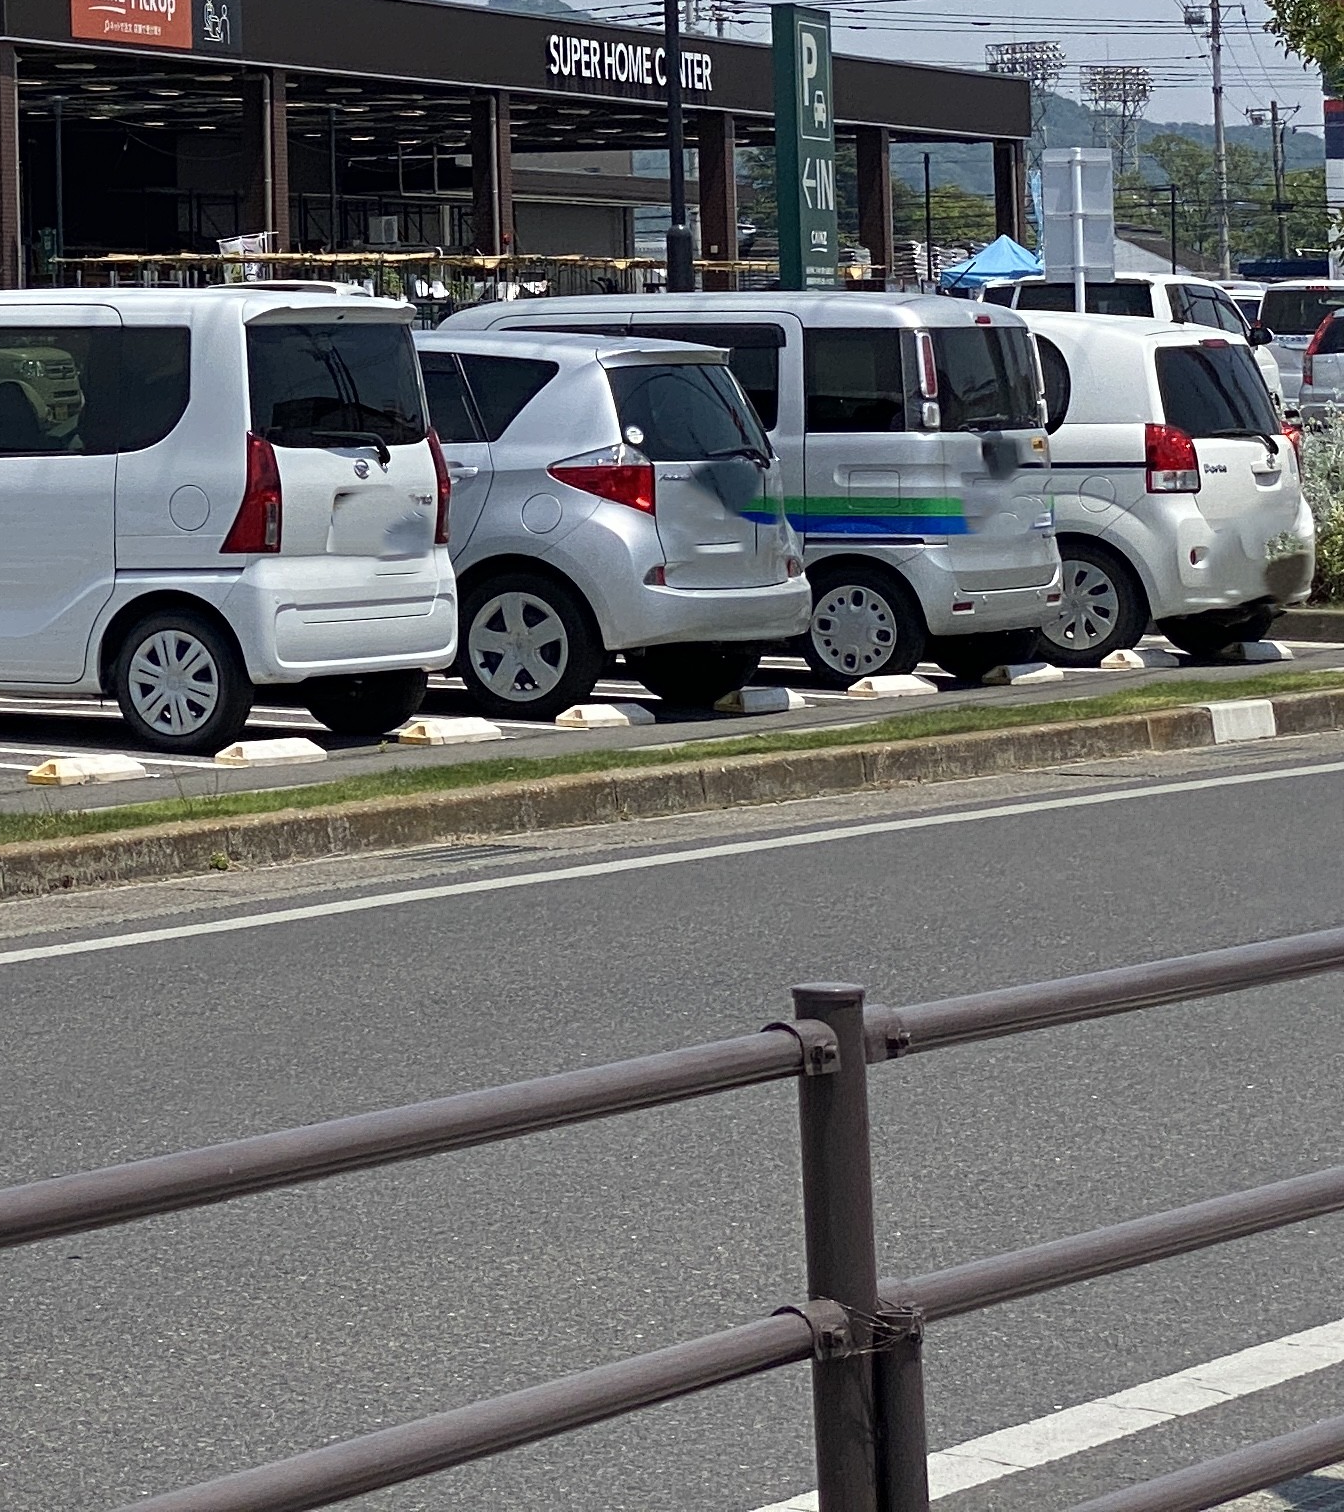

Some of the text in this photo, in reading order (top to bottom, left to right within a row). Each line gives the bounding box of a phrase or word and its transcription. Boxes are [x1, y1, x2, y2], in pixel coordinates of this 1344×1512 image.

[549, 34, 713, 92] SUPER HOME CNTER
[801, 32, 818, 106] P
[815, 158, 834, 211] IN
